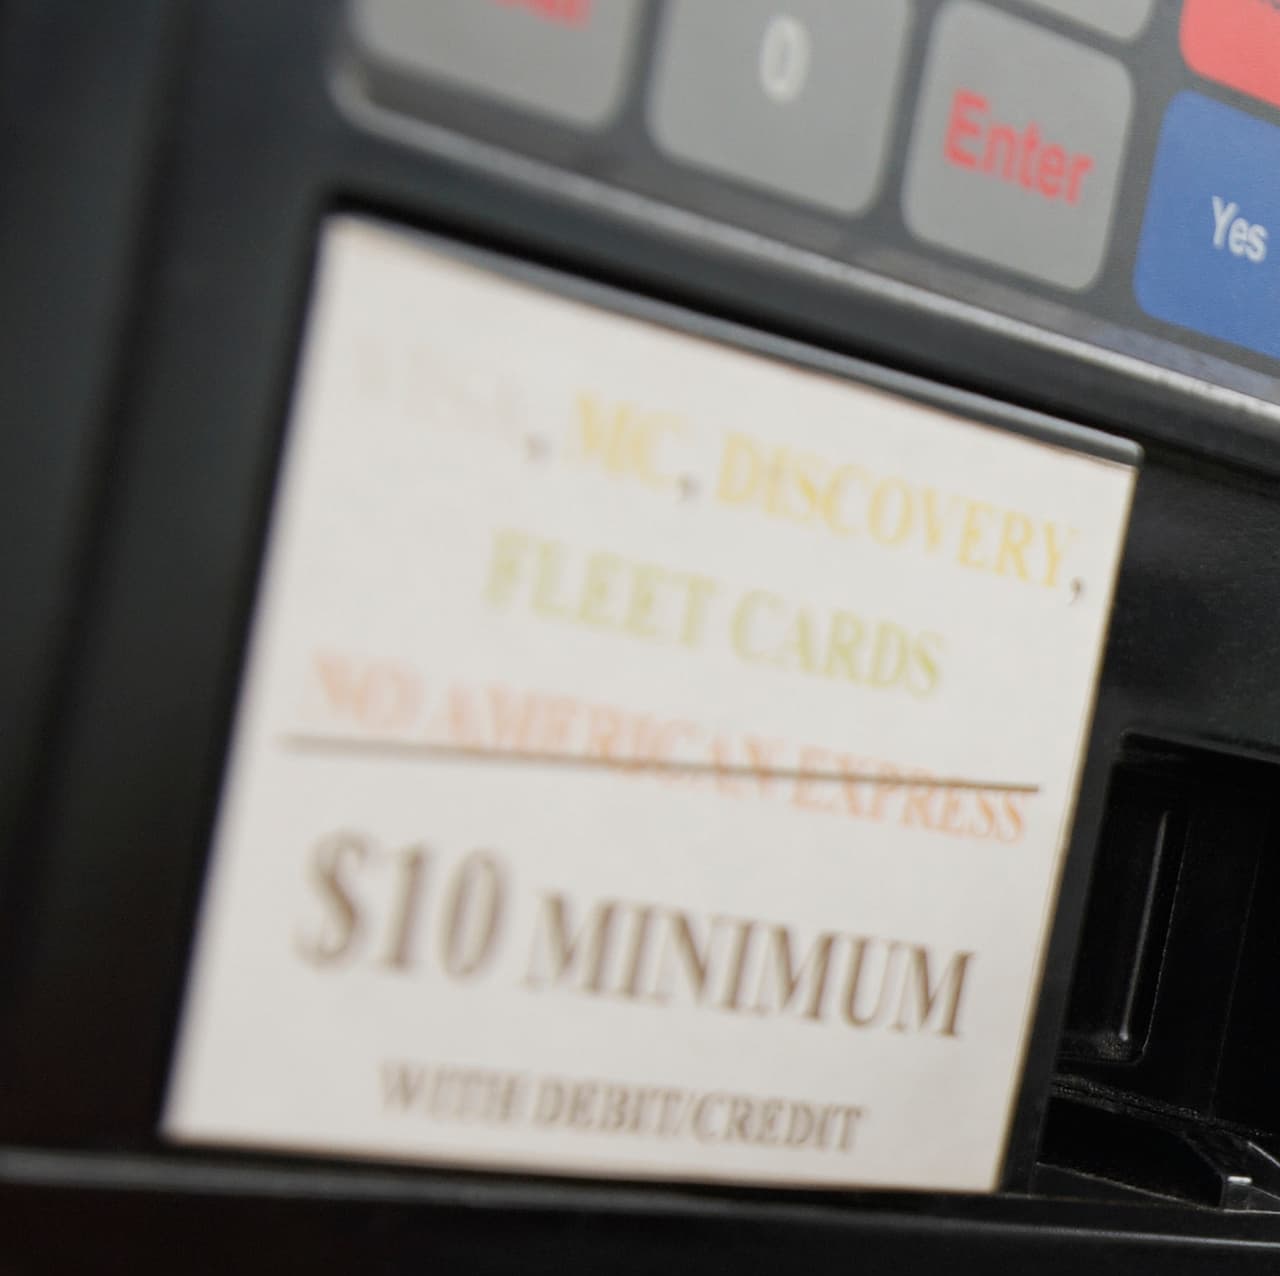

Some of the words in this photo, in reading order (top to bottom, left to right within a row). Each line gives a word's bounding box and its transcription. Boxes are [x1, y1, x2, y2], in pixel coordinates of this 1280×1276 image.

[760, 15, 811, 102] 0
[944, 86, 1095, 208] Enter
[1211, 194, 1269, 263] Yes
[482, 526, 715, 650] FLEET
[730, 585, 945, 700] CARDS
[306, 648, 426, 735] NO
[425, 678, 783, 798] AMERICAN
[788, 743, 1032, 846] EXPRESS
[296, 826, 508, 985] $10
[522, 890, 976, 1040] MINIMUM
[378, 1058, 520, 1126] WITH
[530, 1072, 868, 1153] DEBIT/CREDIT
